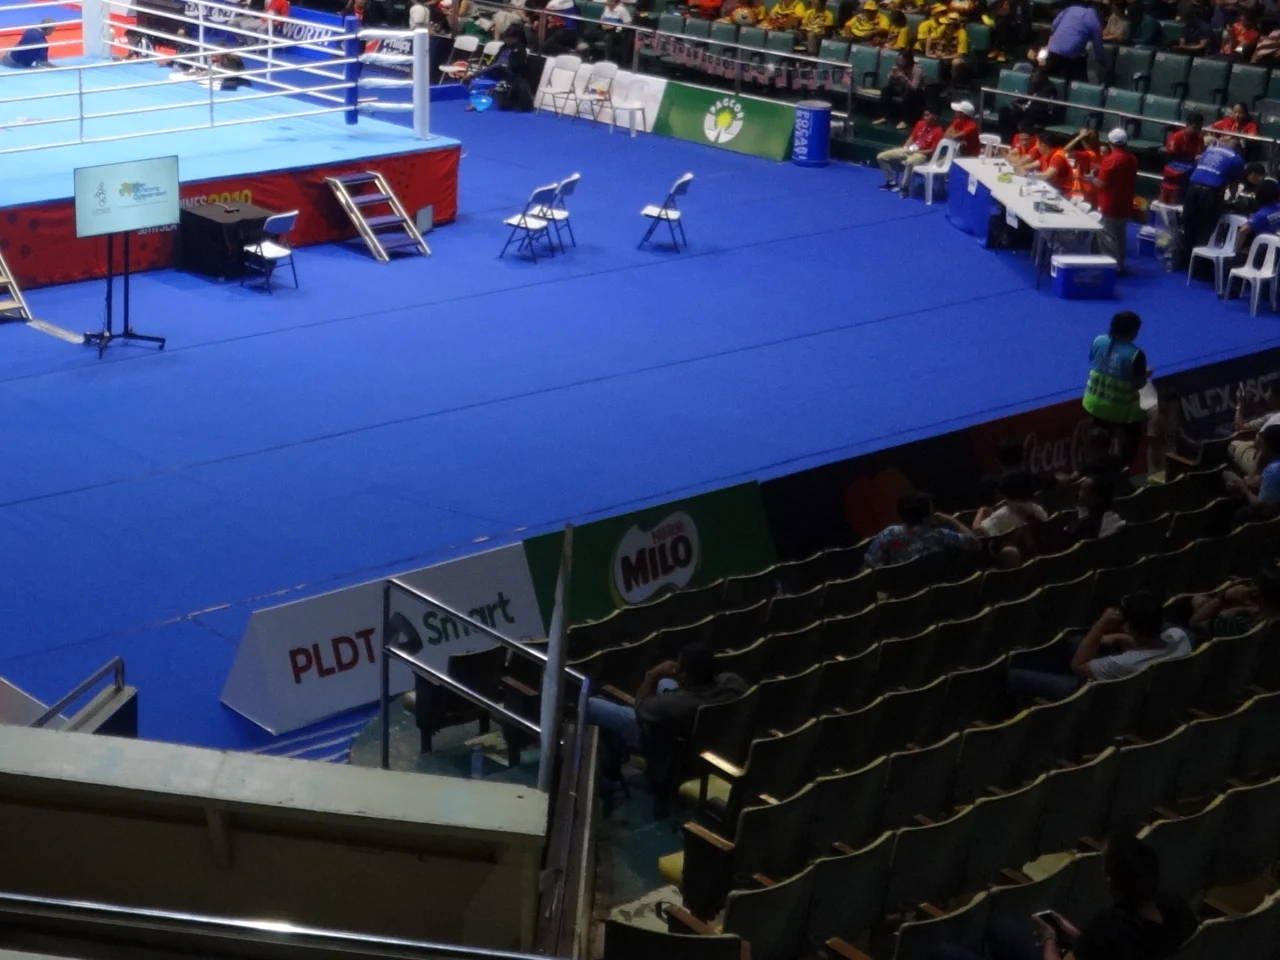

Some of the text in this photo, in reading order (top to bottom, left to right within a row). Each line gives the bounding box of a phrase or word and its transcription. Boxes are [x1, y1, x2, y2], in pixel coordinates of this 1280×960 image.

[710, 98, 745, 120] PAGCOR
[621, 535, 692, 593] MILO
[289, 591, 515, 684] PLDT Smart
